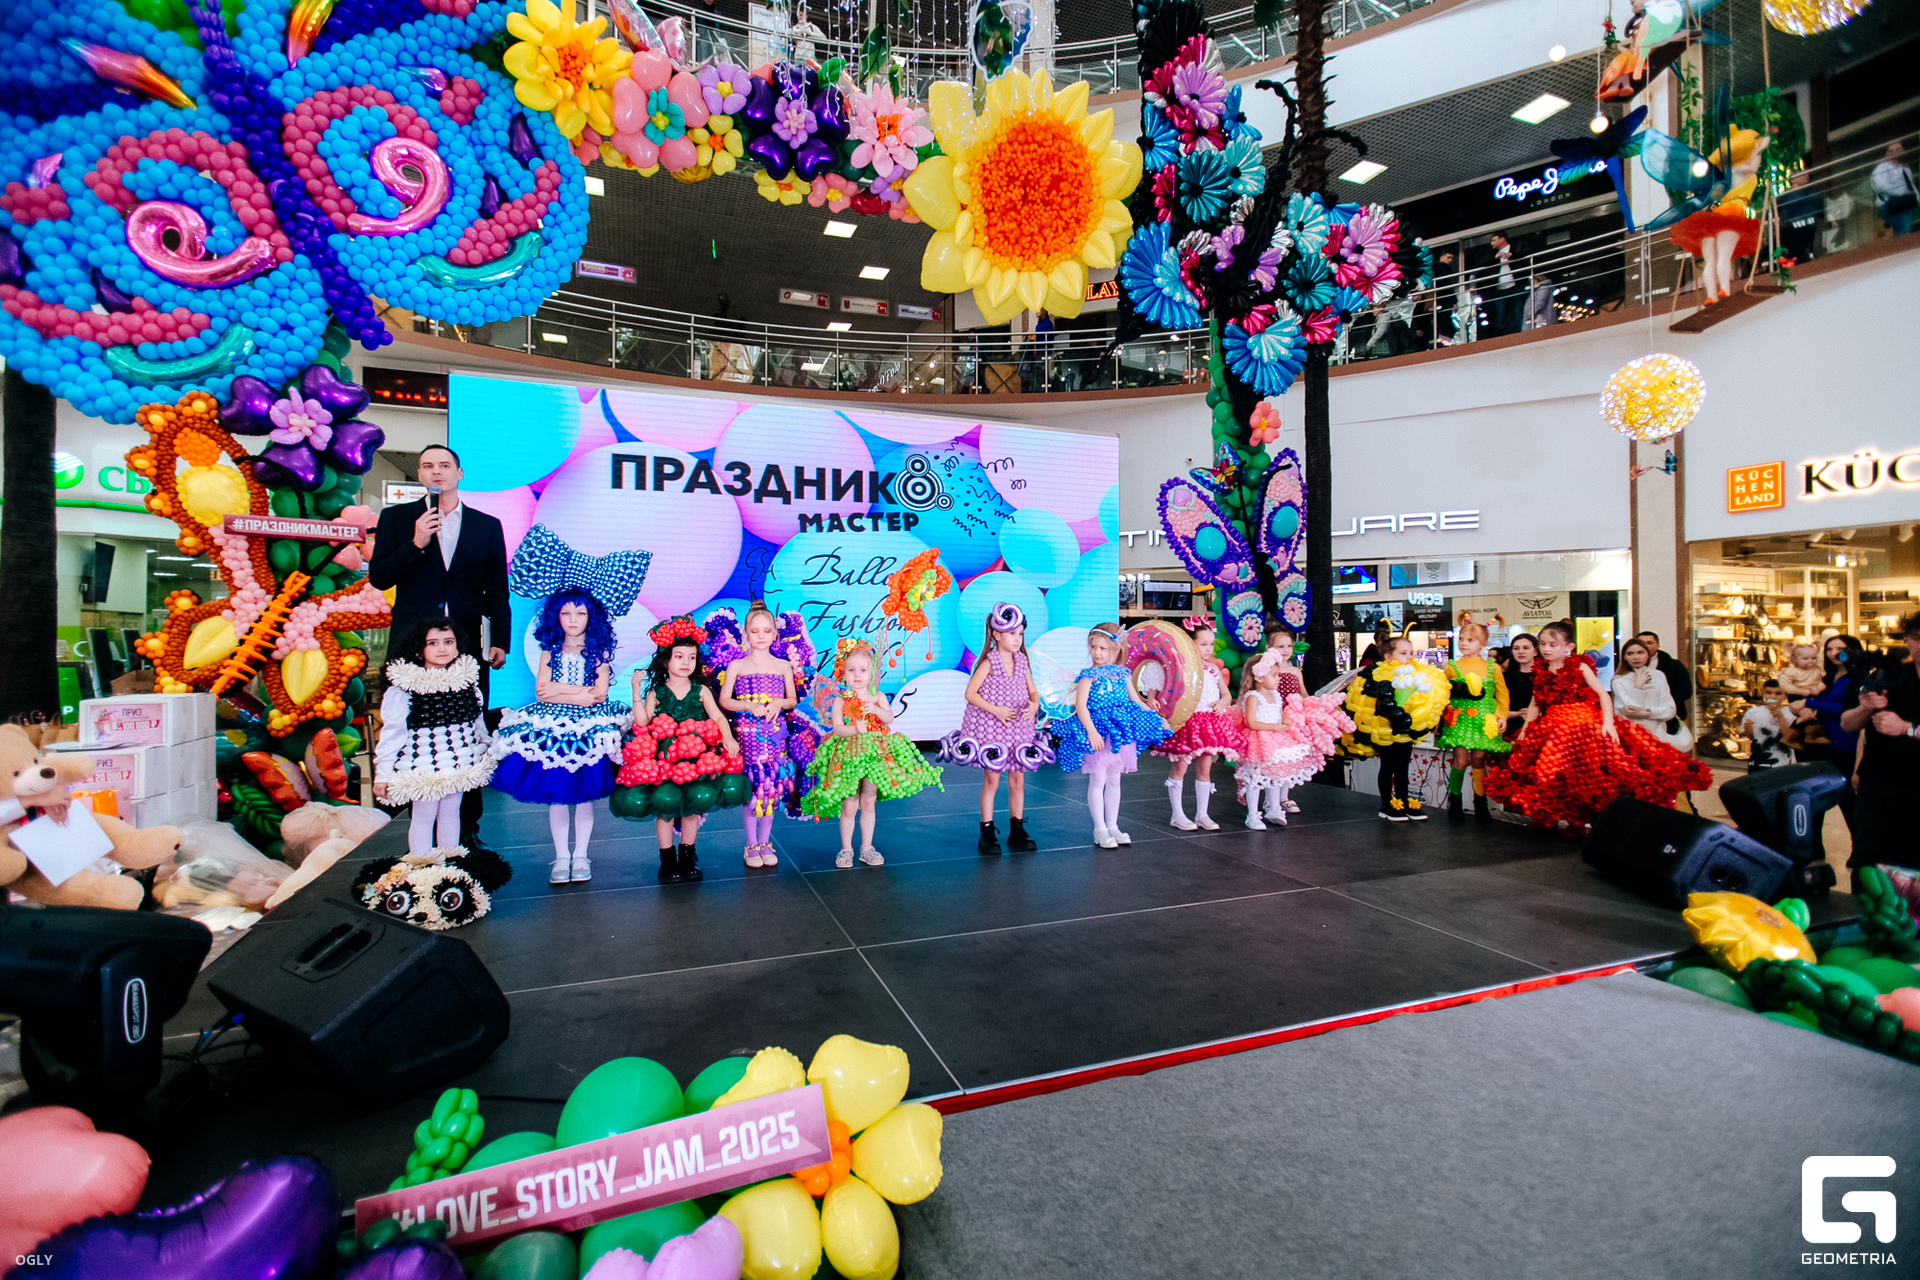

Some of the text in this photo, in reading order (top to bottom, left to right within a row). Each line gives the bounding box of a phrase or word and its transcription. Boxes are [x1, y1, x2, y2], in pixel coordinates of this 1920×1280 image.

[1494, 177, 1543, 201] Pepe
[1530, 192, 1571, 207] LONDON
[98, 466, 155, 494] СБ
[611, 453, 897, 505] ПРАЗДНИК
[1735, 492, 1775, 505] LAND
[232, 518, 359, 538] #ПРАЗДНИКМАСТЕР
[799, 512, 919, 533] МАСТЕР
[1331, 509, 1480, 537] UARE
[122, 708, 142, 716] ПРИЗ
[96, 759, 113, 767] РИЗ
[95, 773, 105, 782] 20
